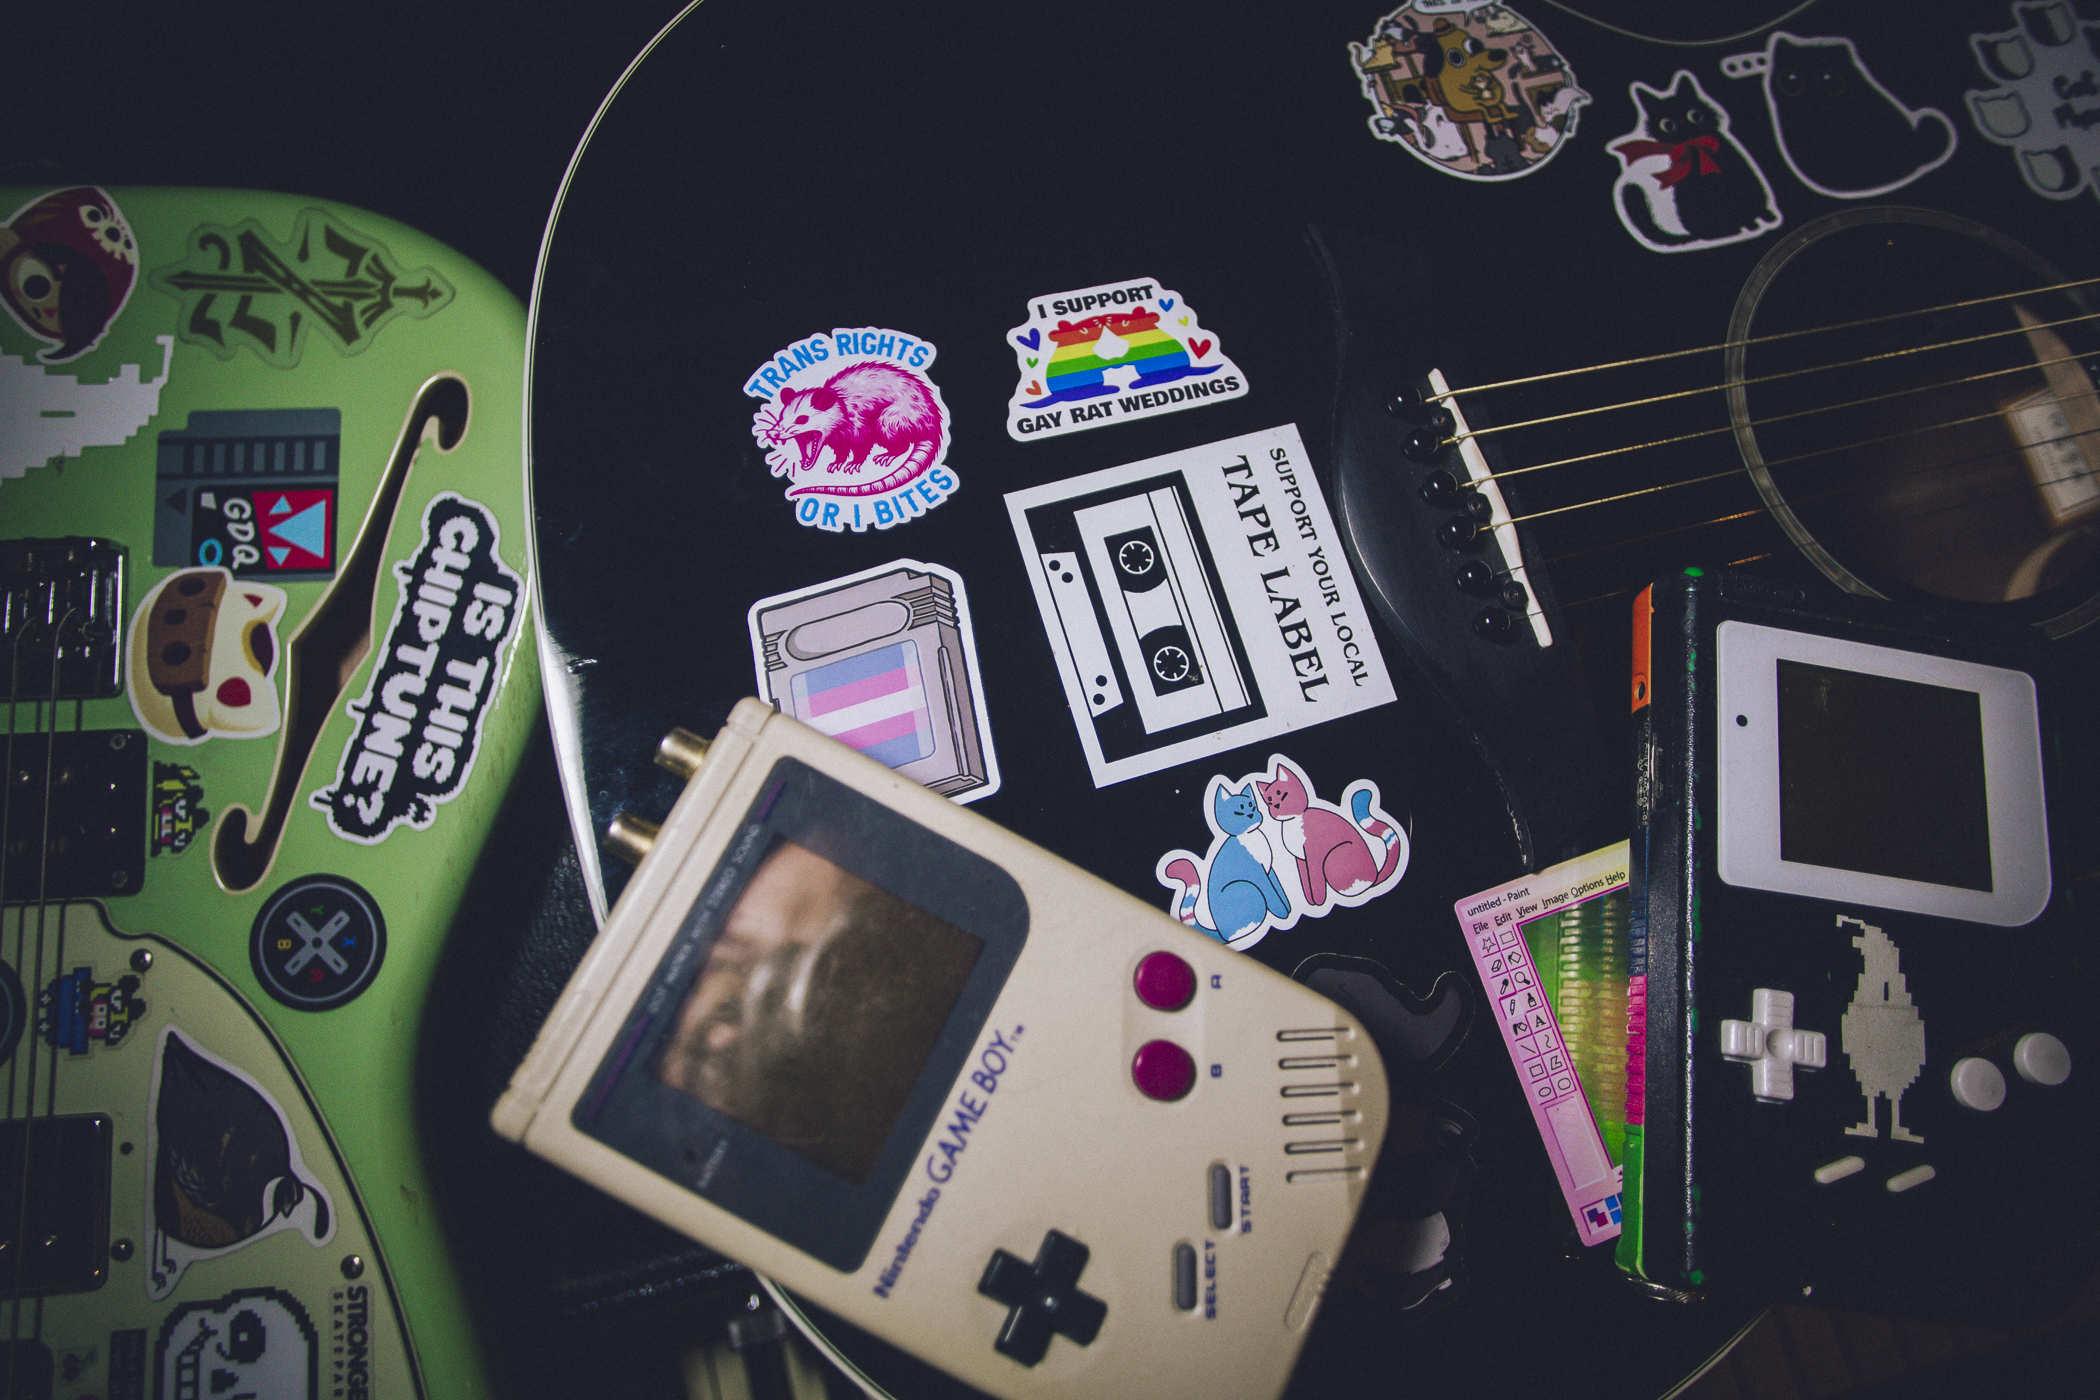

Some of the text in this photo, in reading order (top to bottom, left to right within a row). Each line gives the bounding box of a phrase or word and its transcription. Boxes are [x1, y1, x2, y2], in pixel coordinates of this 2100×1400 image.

[1037, 285, 1153, 319] I SUPPORT
[749, 332, 929, 398] TRANS RIGHTS
[1017, 375, 1240, 434] GAY RAT WEDDINGS
[800, 469, 953, 528] OR I BITES
[223, 498, 260, 570] GDQ
[1221, 454, 1329, 703] TAPE LABEL
[1269, 447, 1369, 687] SUPPORT YOUR LOCAL
[412, 582, 513, 785] IS THIS
[1467, 899, 1502, 917] untitled
[1507, 888, 1530, 905] Paint
[1472, 871, 1626, 935] File Edit View Image Options Help
[277, 938, 292, 950] B
[1210, 974, 1222, 990] A
[1210, 1063, 1222, 1078] B
[873, 1187, 942, 1299] Nintendo
[927, 1091, 988, 1184] GAME
[1239, 1166, 1252, 1233] START
[1205, 1240, 1217, 1320] SELECT
